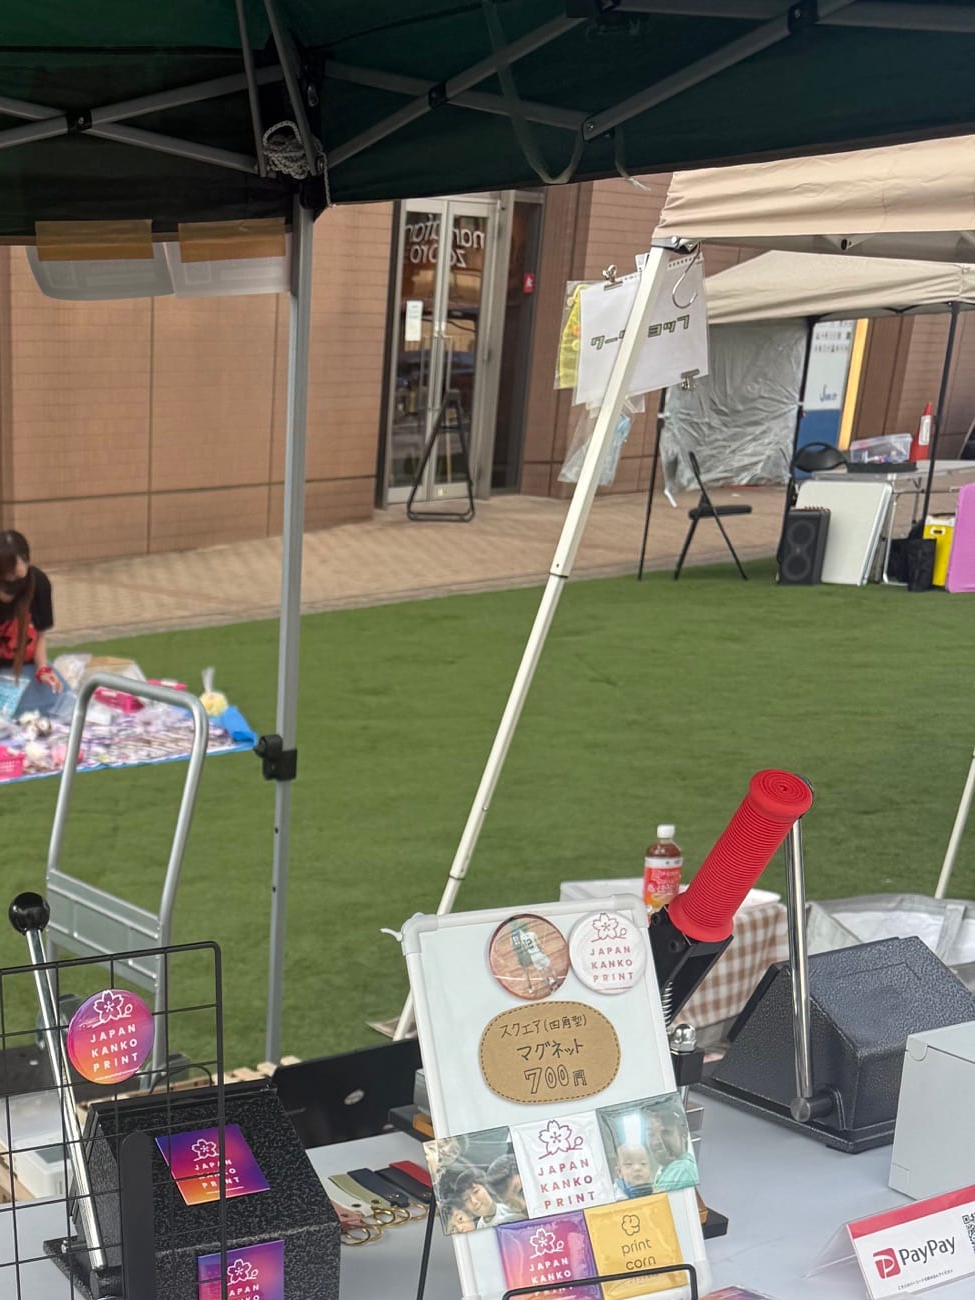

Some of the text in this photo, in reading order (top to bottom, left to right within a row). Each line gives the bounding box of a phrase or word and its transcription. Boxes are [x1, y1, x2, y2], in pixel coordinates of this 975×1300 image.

[590, 946, 631, 956] JAPAN
[591, 959, 633, 969] KANKO
[593, 972, 634, 982] PRINT
[90, 1024, 136, 1043] JAPAN
[91, 1039, 138, 1058] KANKO
[516, 1038, 584, 1061] マグネット
[93, 1053, 138, 1072] PRINT
[523, 1064, 587, 1094] 700円
[194, 1159, 232, 1171] JAPN
[538, 1158, 589, 1176] JAPAN
[201, 1176, 241, 1189] PRNT
[540, 1175, 593, 1193] KANKO
[544, 1191, 595, 1209] PRINT
[621, 1238, 652, 1256] print
[898, 1236, 955, 1266] PayPay
[529, 1257, 569, 1272] JAPAN
[625, 1255, 657, 1270] corn
[531, 1269, 572, 1285] KANKO
[228, 1284, 260, 1297] APAN
